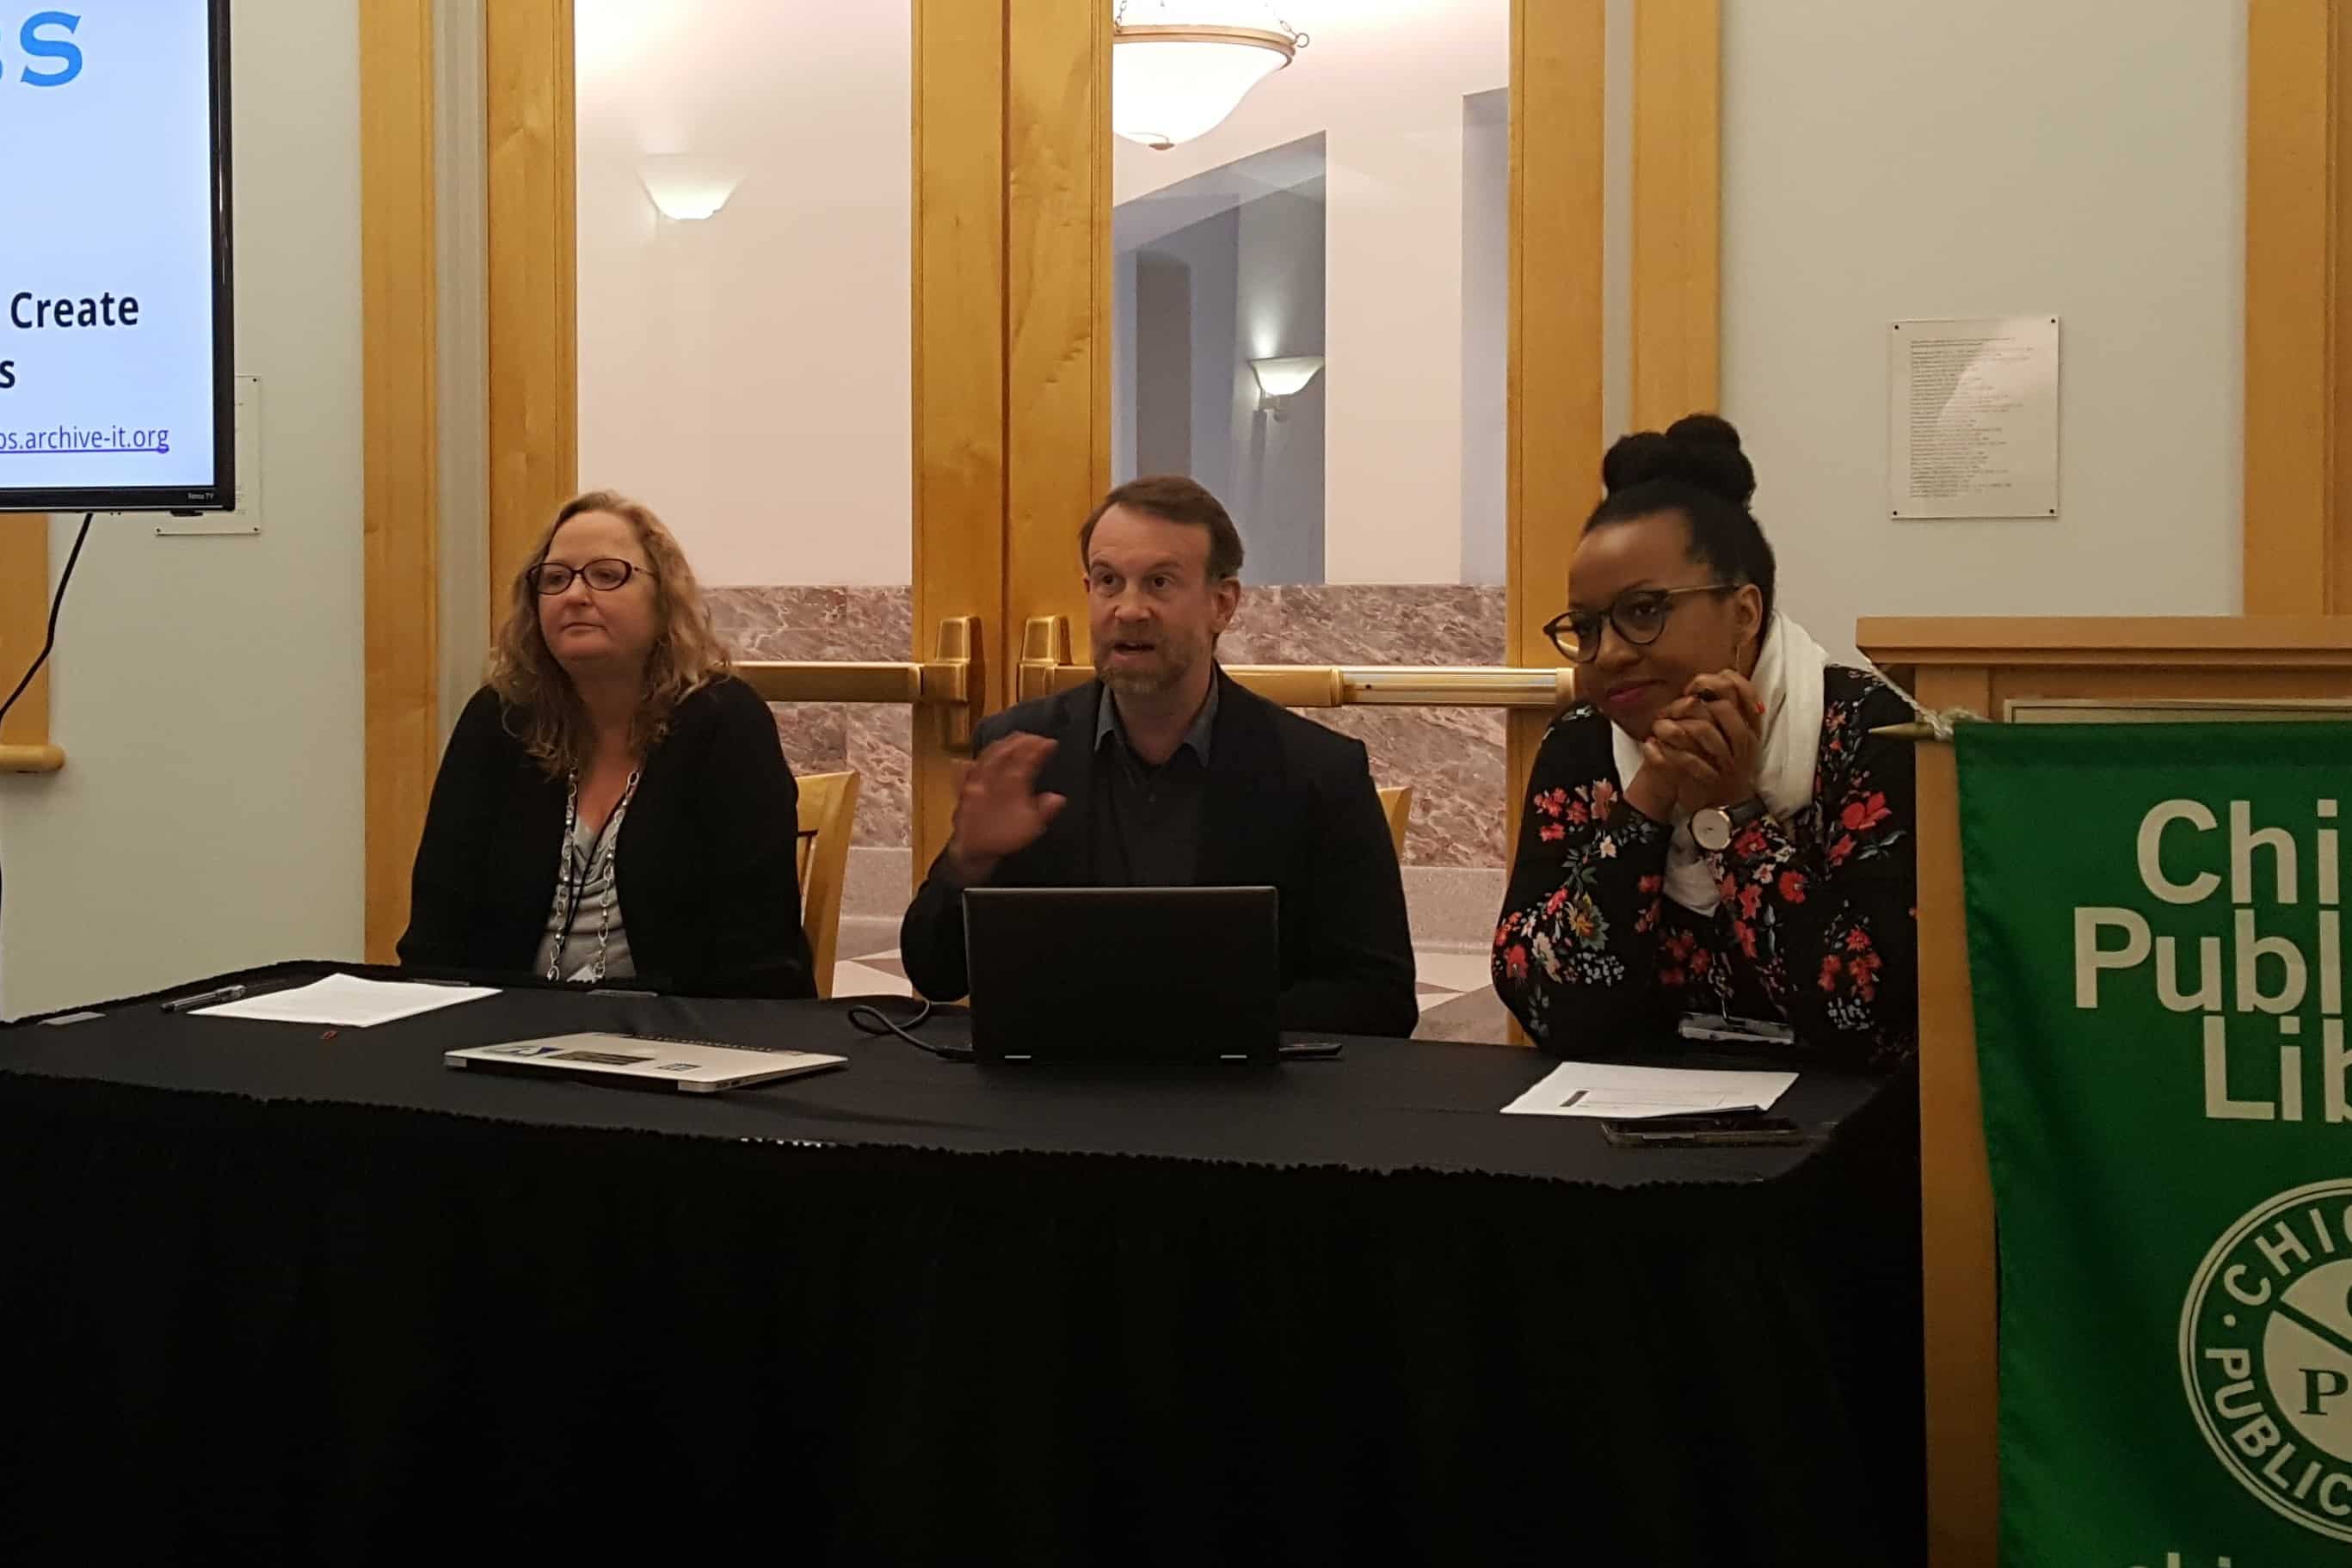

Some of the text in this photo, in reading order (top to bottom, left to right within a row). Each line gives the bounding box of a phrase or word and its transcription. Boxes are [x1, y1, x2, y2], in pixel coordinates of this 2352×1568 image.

[0, 11, 83, 87] S
[10, 292, 139, 329] Create
[0, 360, 15, 389] s
[2137, 799, 2340, 904] Chi
[2074, 907, 2343, 1014] Publ
[2224, 1204, 2352, 1306] CHI
[2205, 1348, 2352, 1516] PUBLIC
